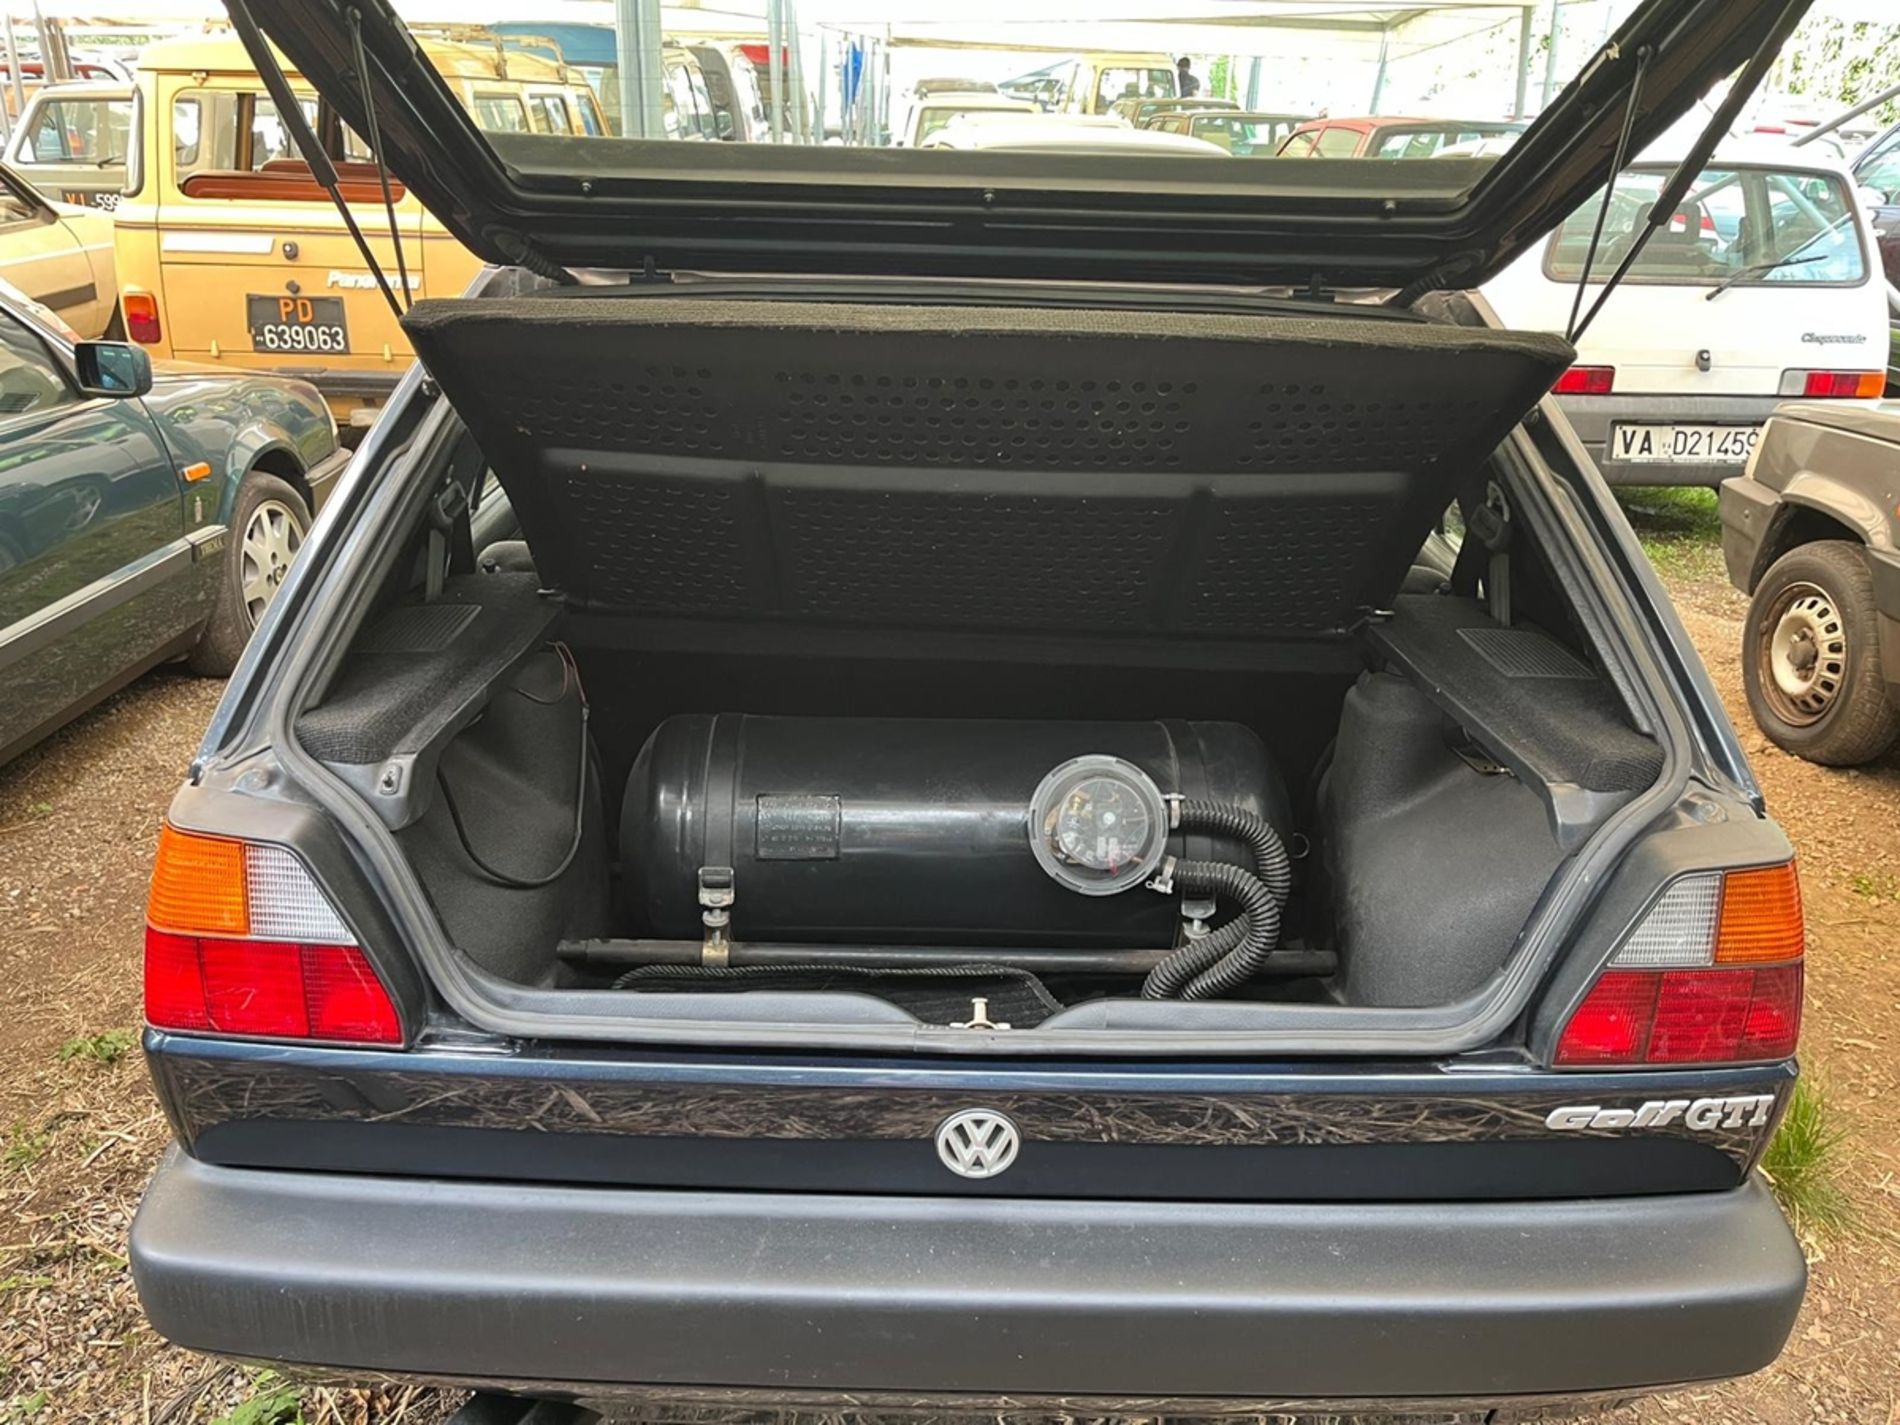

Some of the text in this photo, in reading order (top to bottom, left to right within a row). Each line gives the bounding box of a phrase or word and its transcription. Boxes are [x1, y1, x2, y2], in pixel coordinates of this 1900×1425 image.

[279, 297, 314, 323] PD
[263, 324, 346, 350] 639063
[1621, 430, 1653, 455] VA
[1545, 1094, 1776, 1131] Golf GTI
